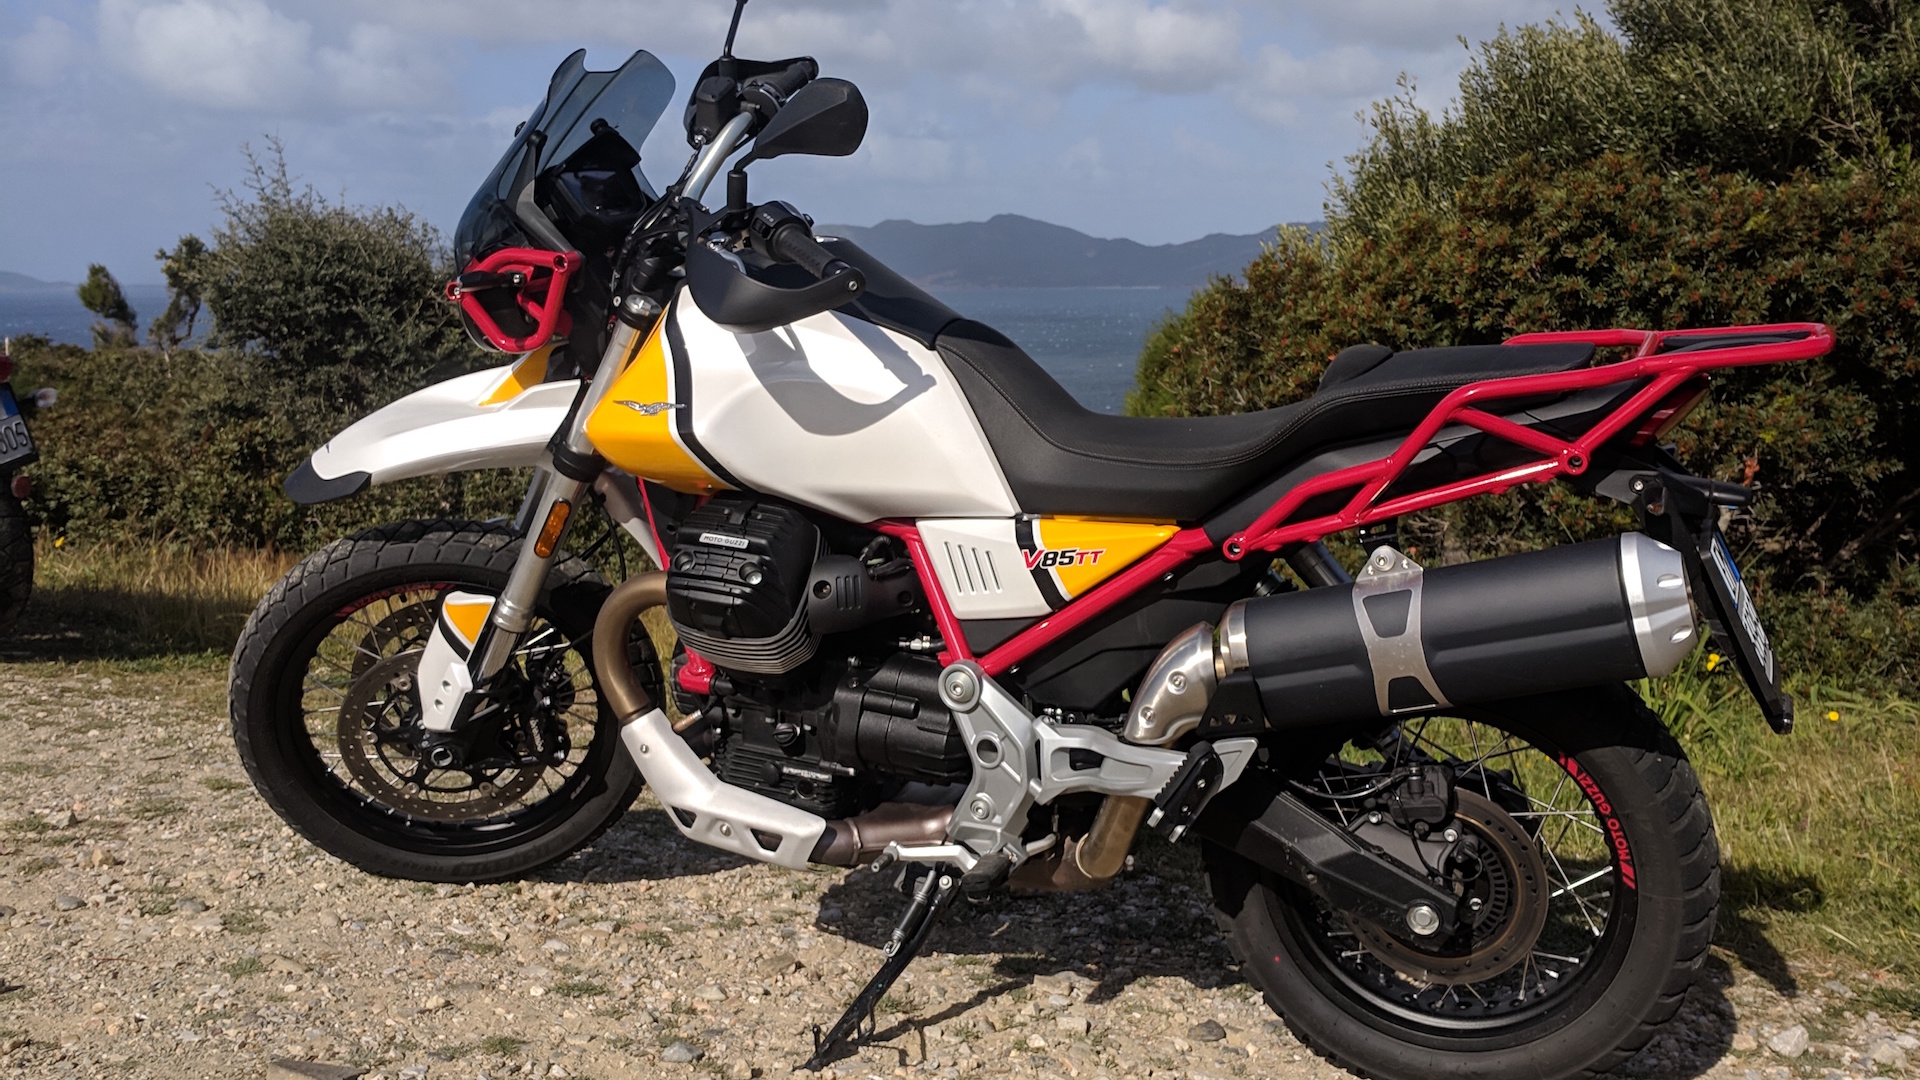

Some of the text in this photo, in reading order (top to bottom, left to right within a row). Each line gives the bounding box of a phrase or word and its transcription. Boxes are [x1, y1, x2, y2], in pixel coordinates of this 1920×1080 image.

[703, 535, 746, 547] MOTO GUZZI
[1577, 773, 1631, 860] MOTO GUZZI
